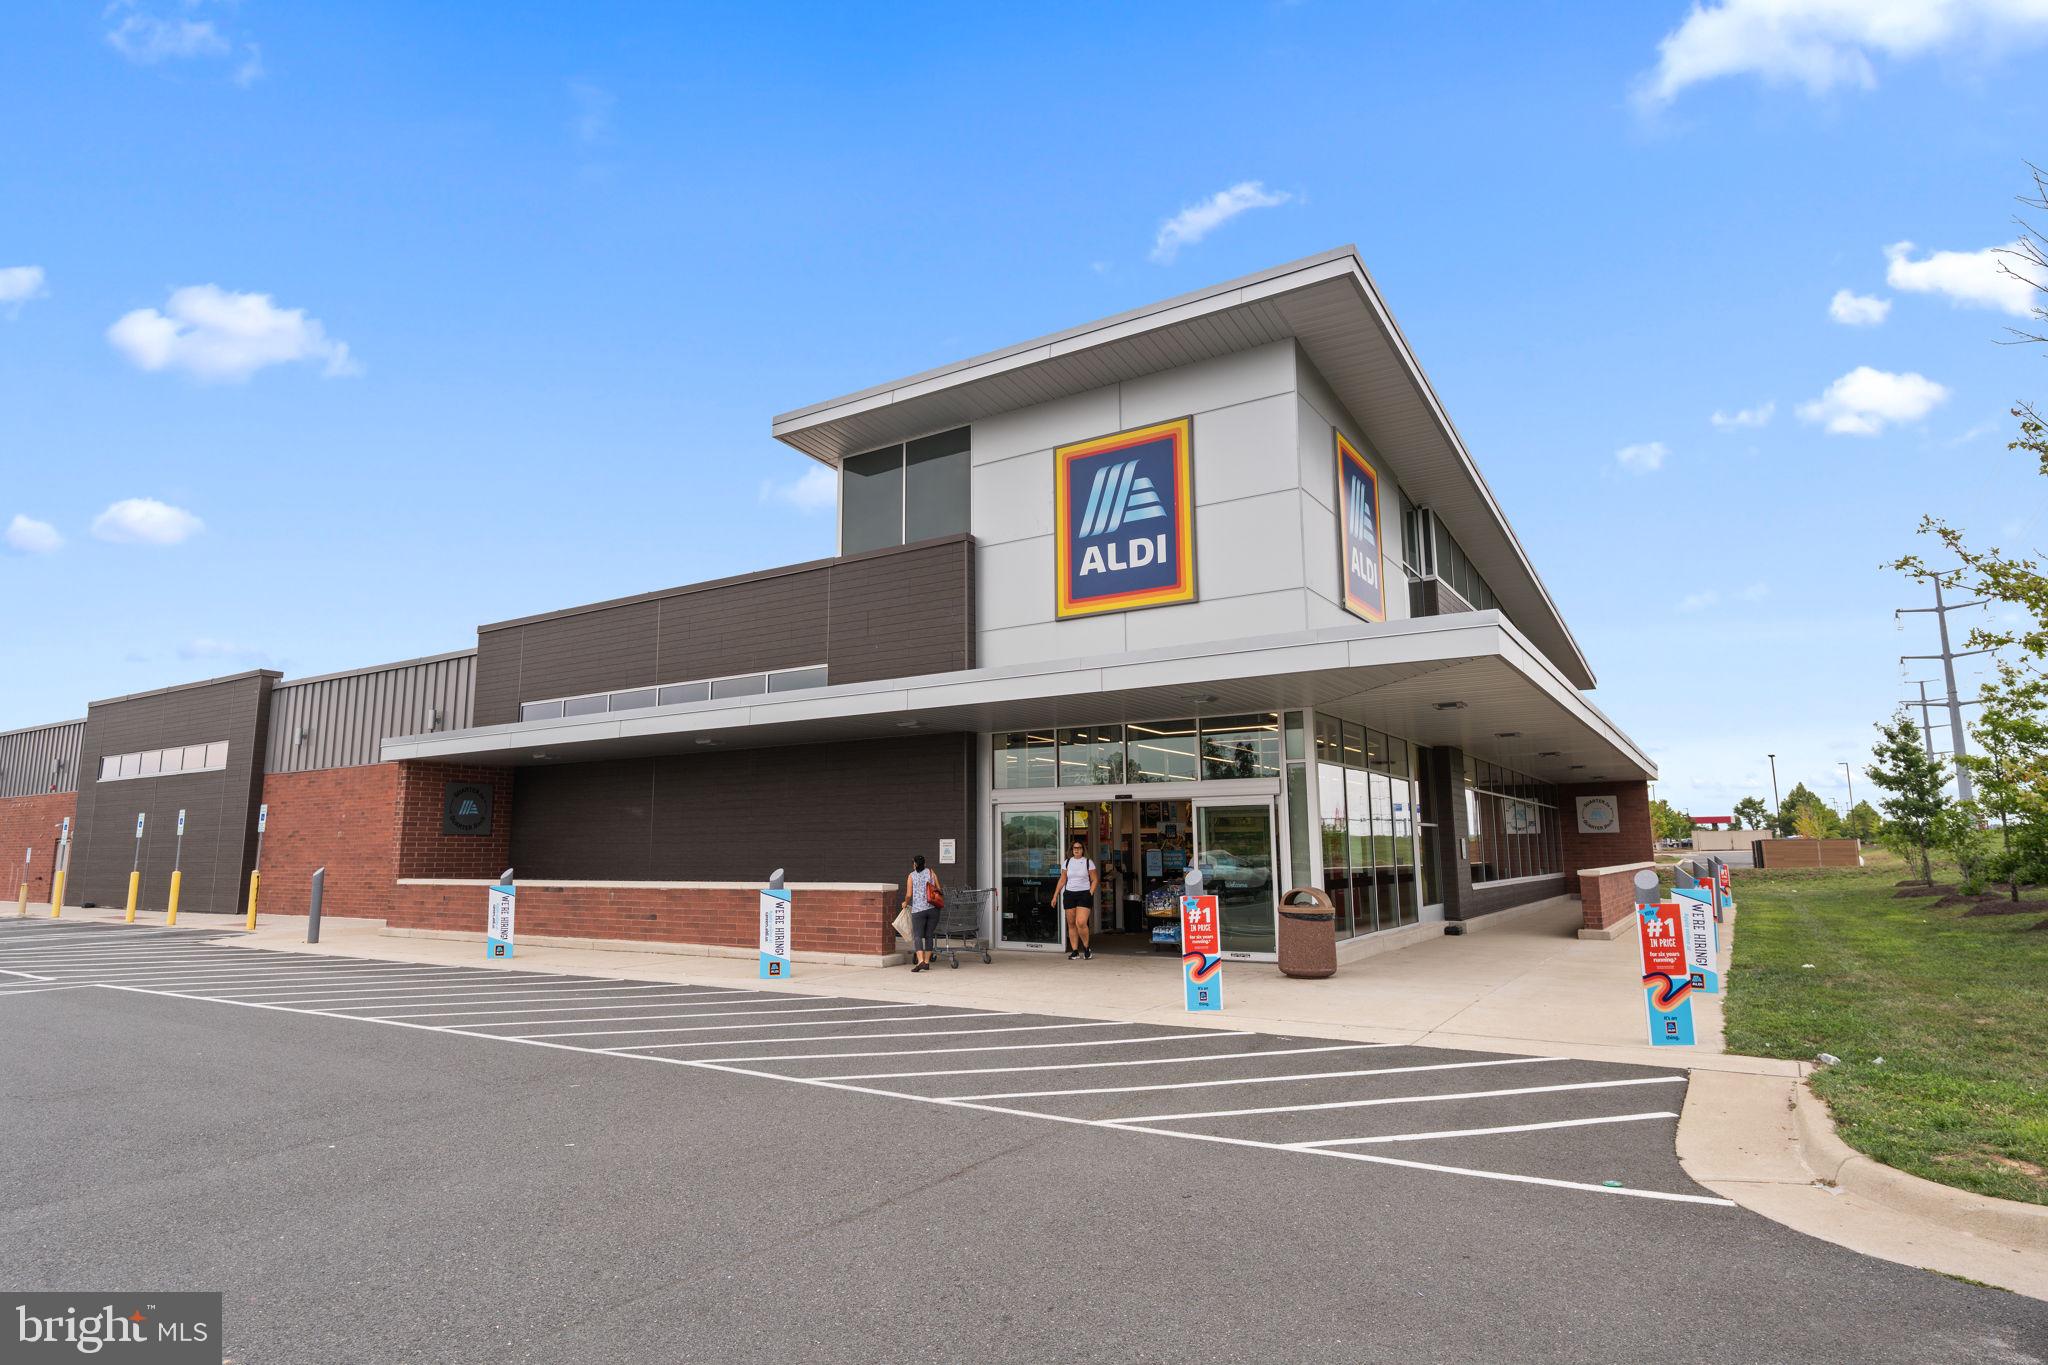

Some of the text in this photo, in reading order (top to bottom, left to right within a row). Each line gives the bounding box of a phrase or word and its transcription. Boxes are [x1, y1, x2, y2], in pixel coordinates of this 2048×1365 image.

[1079, 533, 1167, 577] ALDI
[1351, 546, 1378, 590] ALDI
[1225, 880, 1249, 889] Welcome
[501, 895, 510, 915] WE'RE
[1189, 907, 1211, 923] #1
[1647, 917, 1676, 938] #1
[1692, 903, 1706, 930] WE'RE
[500, 917, 509, 940] HIRING!
[775, 901, 785, 955] WE'RE HIRING!
[1190, 924, 1211, 932] IN PRICE
[1649, 938, 1677, 947] IN PRICE
[1694, 933, 1708, 967] HIRING!
